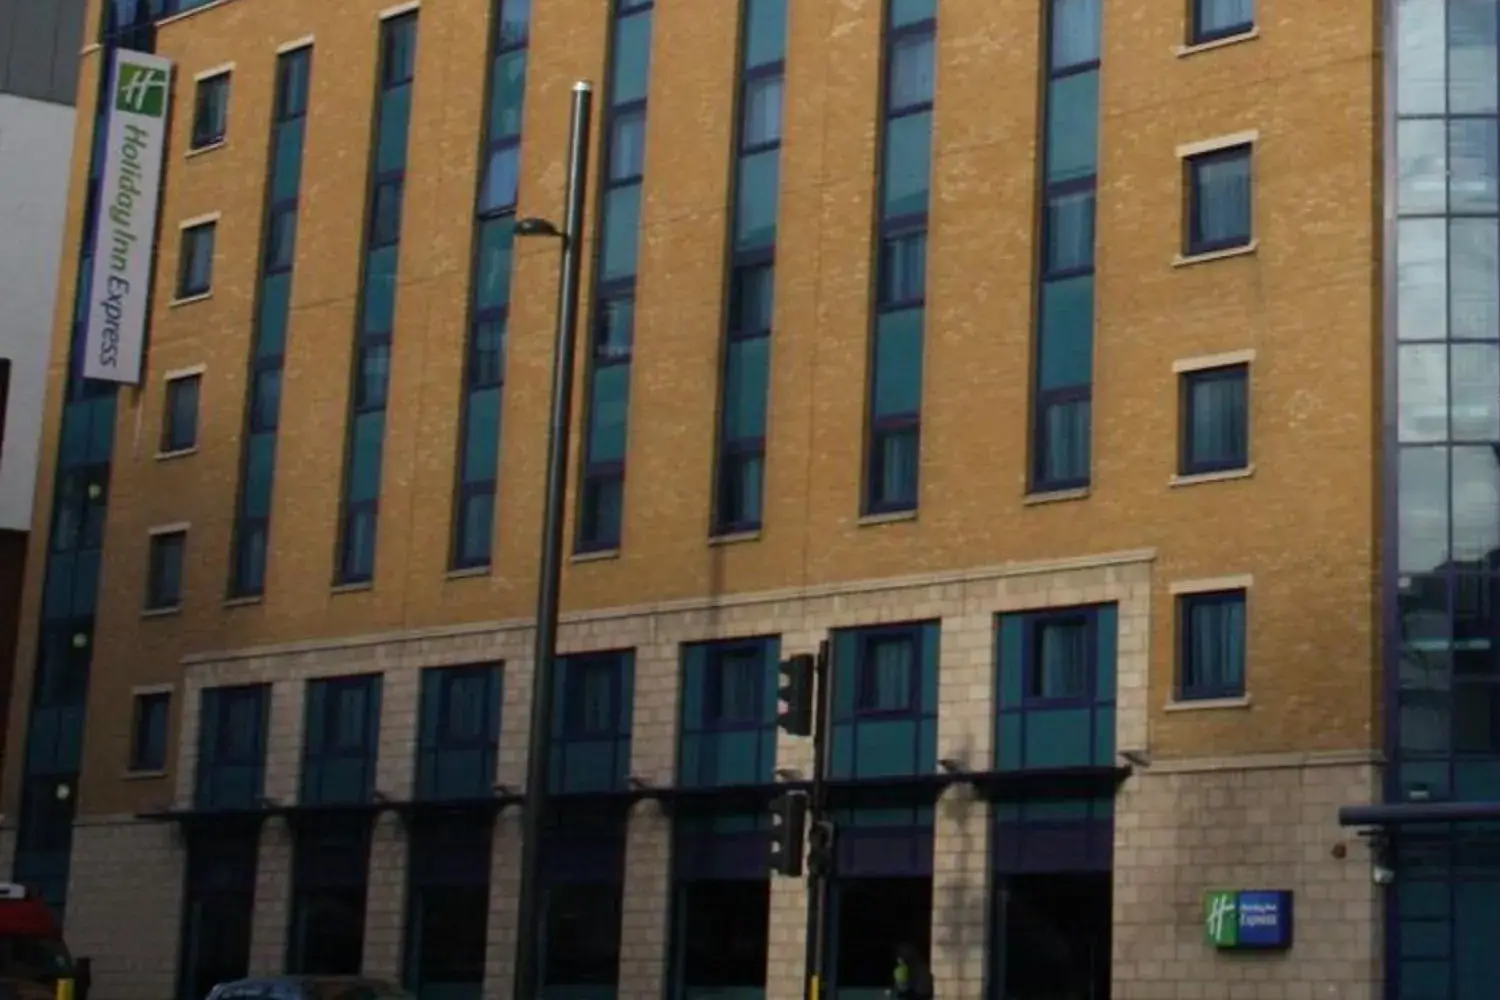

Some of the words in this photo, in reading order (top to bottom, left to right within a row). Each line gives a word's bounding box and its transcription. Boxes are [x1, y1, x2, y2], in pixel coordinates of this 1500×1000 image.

[109, 123, 149, 228] Holiday
[110, 229, 139, 271] Inn
[99, 274, 130, 369] Express
